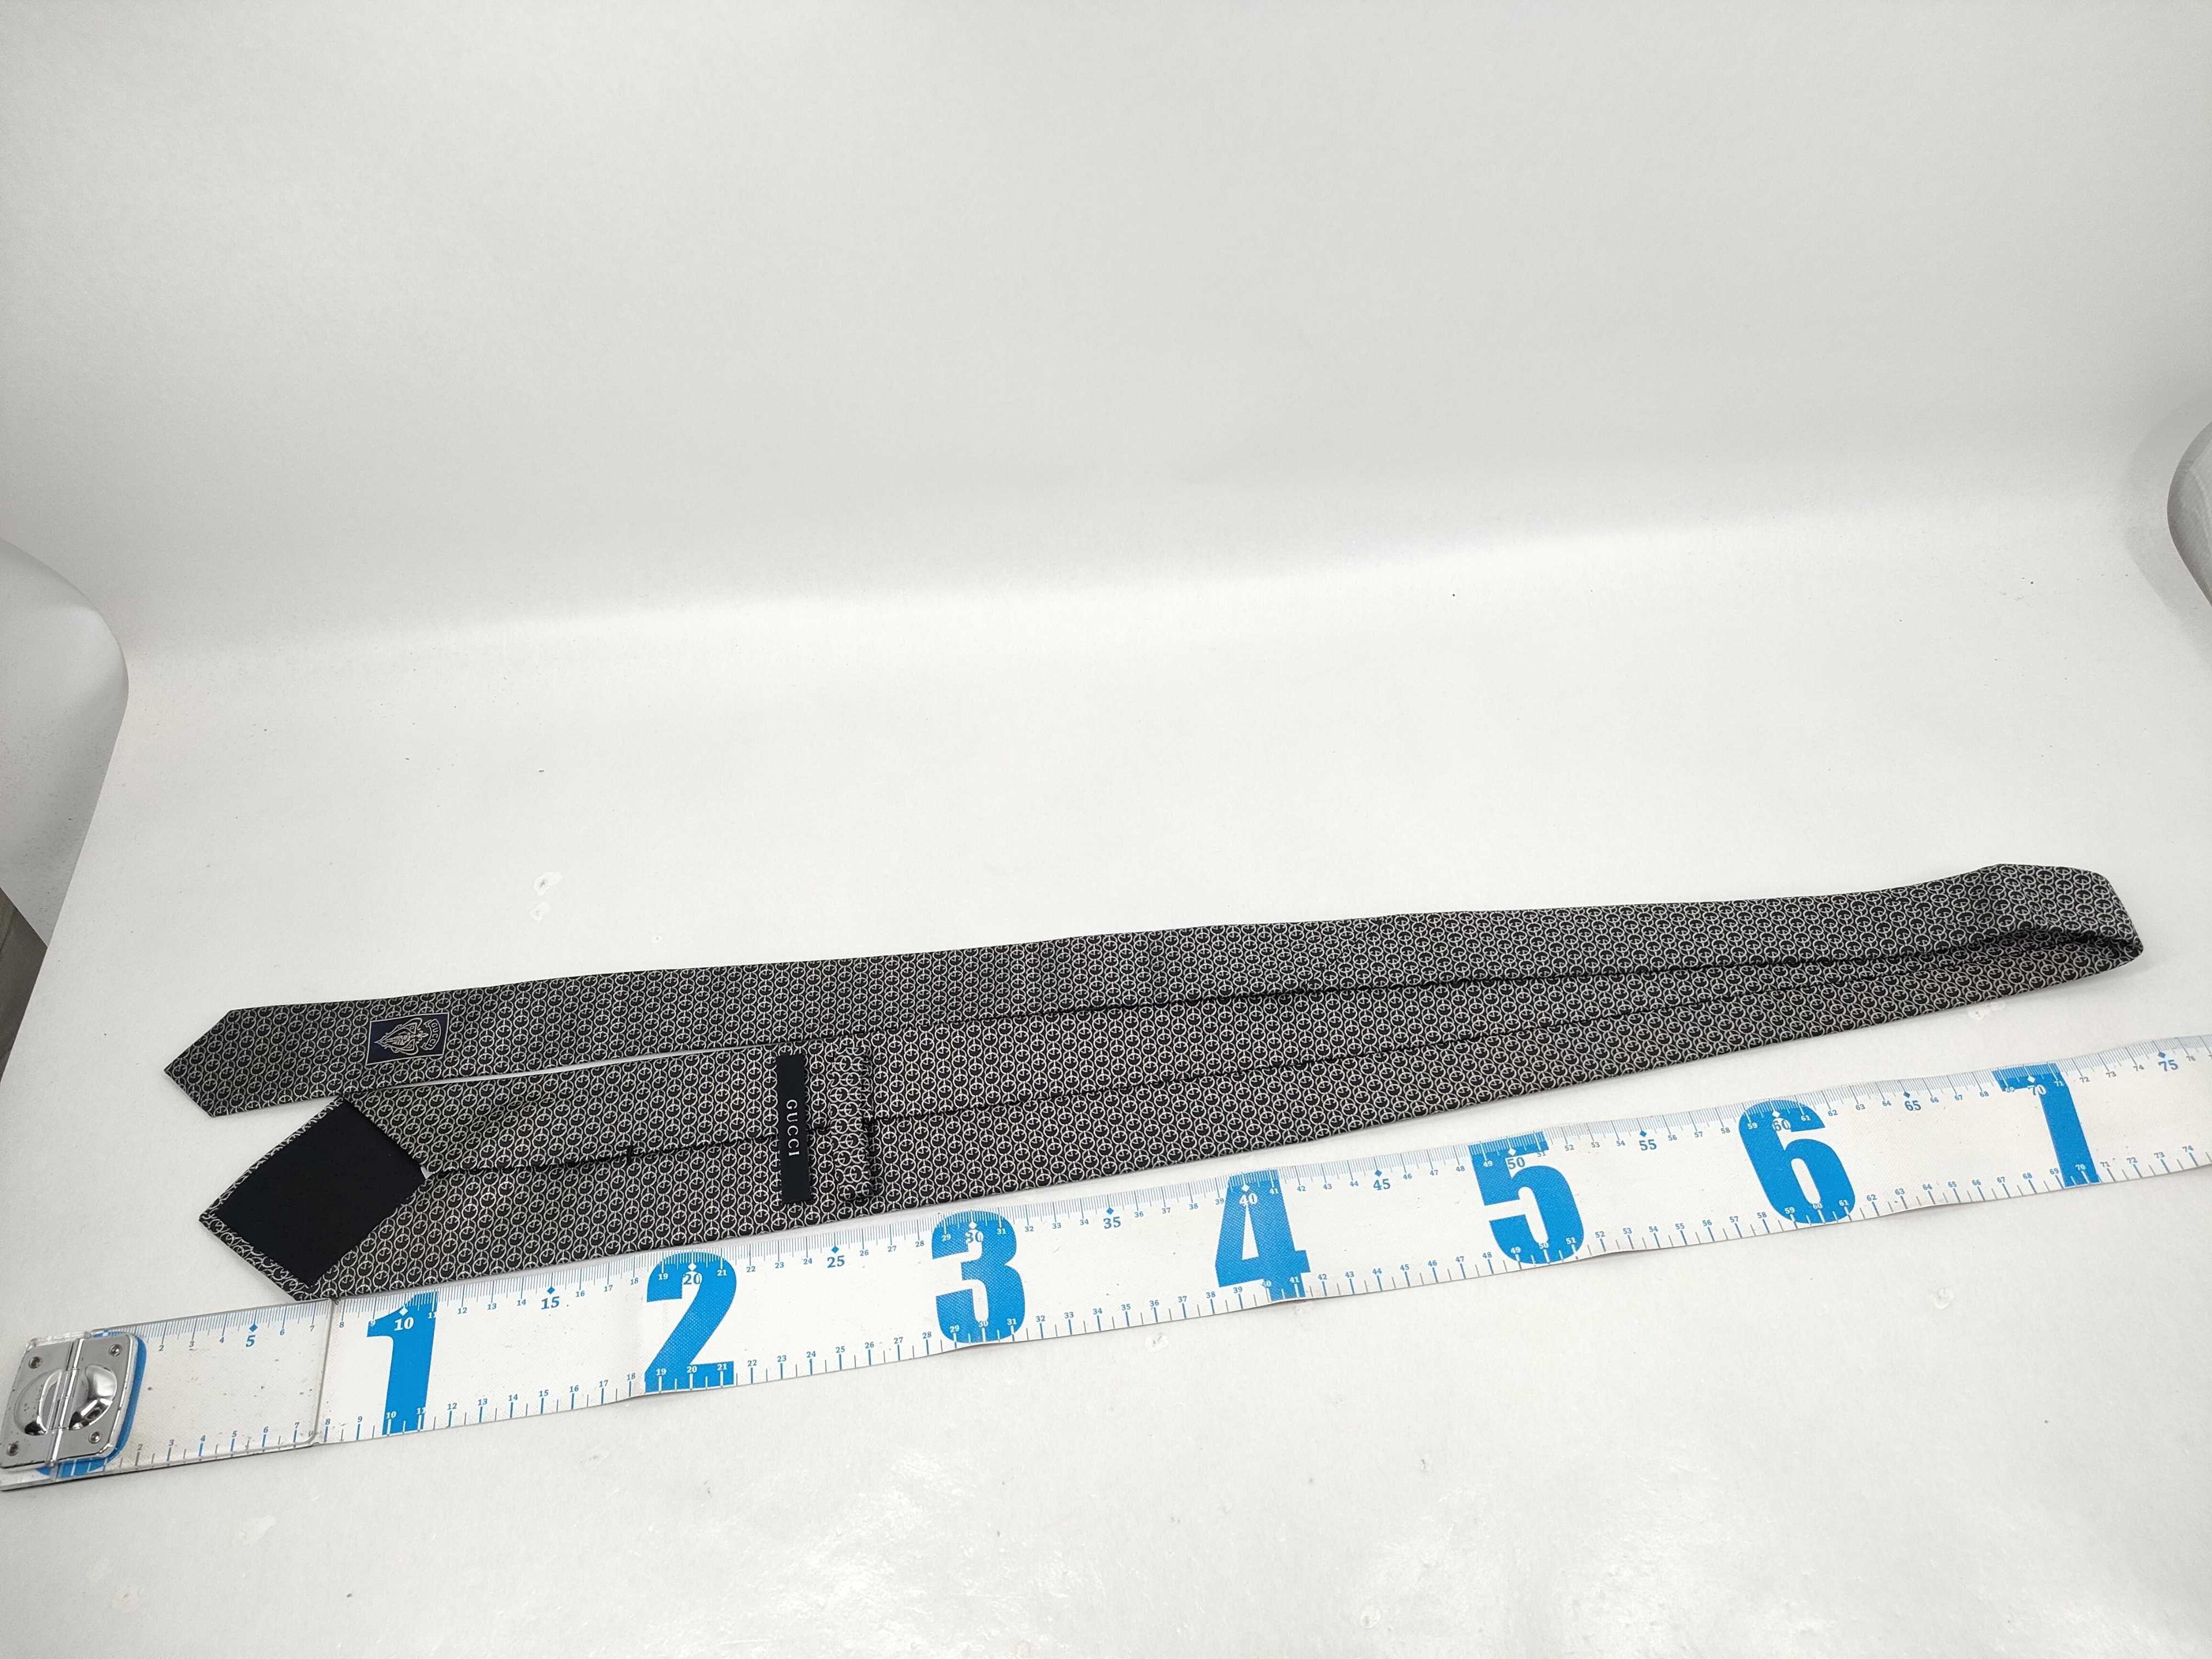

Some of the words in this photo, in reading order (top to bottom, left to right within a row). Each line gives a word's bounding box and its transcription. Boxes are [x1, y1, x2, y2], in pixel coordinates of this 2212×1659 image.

[428, 1022, 439, 1047] GUCCI
[786, 1099, 800, 1156] GUCCI
[189, 1340, 195, 1348] 3
[245, 1335, 256, 1347] 5
[394, 1317, 414, 1331] 10
[540, 1296, 560, 1310] 15
[630, 1277, 639, 1285] 18
[658, 1272, 668, 1280] 19
[683, 1272, 702, 1285] 20
[827, 1255, 845, 1268] 25
[964, 1230, 984, 1244] 30
[1079, 1218, 1090, 1226] 34
[1103, 1216, 1121, 1229] 35
[1239, 1193, 1258, 1205] 40
[1372, 1178, 1391, 1190] 45
[1507, 1156, 1526, 1170] 50
[1638, 1139, 1657, 1151] 55
[1772, 1120, 1791, 1132] 60
[1904, 1100, 1922, 1111] 65
[2028, 1084, 2047, 1096] 70
[2158, 1059, 2179, 1071] 75
[367, 1291, 439, 1435] 1
[645, 1252, 736, 1392] 2
[932, 1211, 1025, 1344] 3
[1215, 1170, 1311, 1301] 4
[1469, 1131, 1584, 1264] 5
[1739, 1100, 1855, 1223] 6
[1992, 1062, 2100, 1187] 7
[137, 1443, 143, 1451] 2
[294, 1421, 300, 1430] 7
[386, 1410, 397, 1419] 10
[447, 1402, 458, 1410] 12
[508, 1393, 518, 1402] 14
[569, 1385, 579, 1393] 16
[599, 1380, 609, 1388] 17
[626, 1373, 636, 1381] 18
[893, 1336, 904, 1345] 27
[949, 1325, 960, 1334] 29
